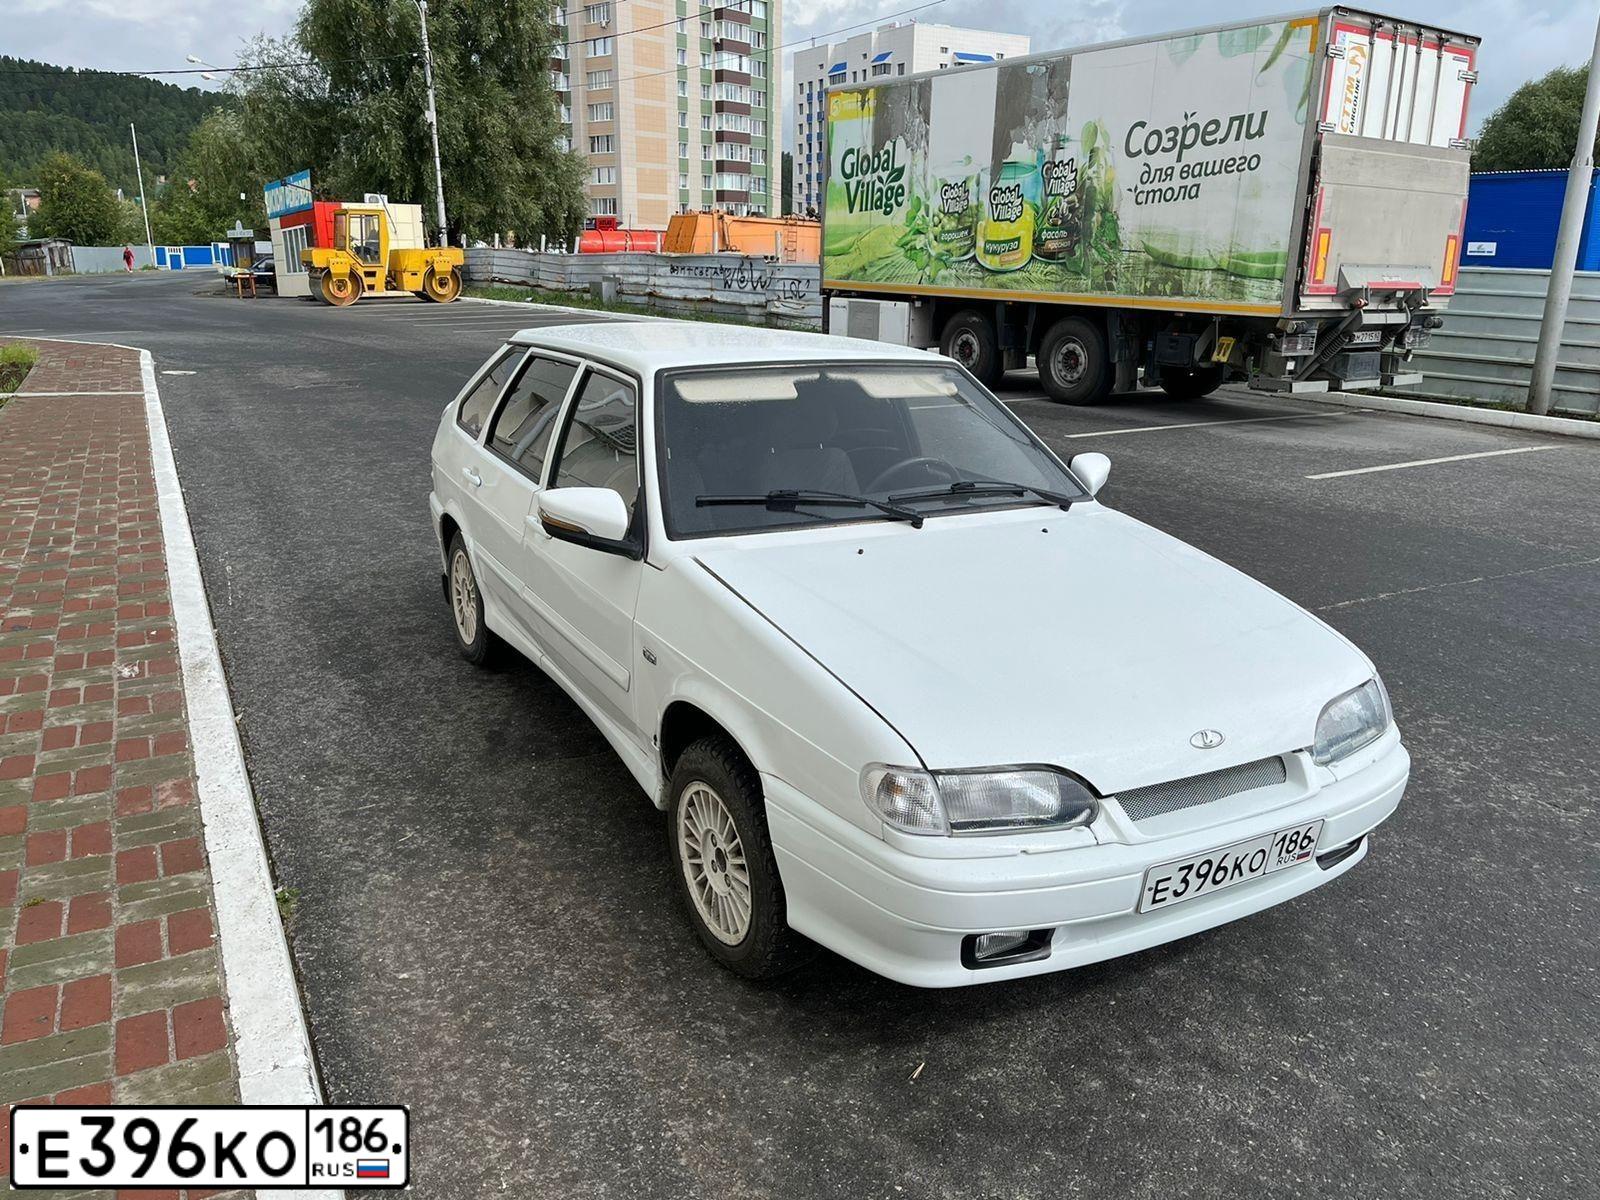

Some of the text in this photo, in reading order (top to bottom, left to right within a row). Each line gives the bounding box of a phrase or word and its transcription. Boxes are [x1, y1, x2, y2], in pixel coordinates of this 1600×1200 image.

[1349, 77, 1361, 133] CARGOLINE
[1124, 110, 1268, 163] Созрели
[841, 141, 896, 180] Global
[1140, 153, 1261, 185] для вашего
[941, 182, 967, 199] Global
[990, 186, 1019, 204] Global
[1043, 177, 1076, 196] Village
[1134, 183, 1201, 206] стола
[844, 179, 905, 216] Village
[992, 202, 1022, 221] Village
[1041, 229, 1068, 241] фасоль
[985, 241, 1019, 254] кукуруза
[1151, 826, 1314, 905] Е396КО 186
[1276, 852, 1297, 866] RUS
